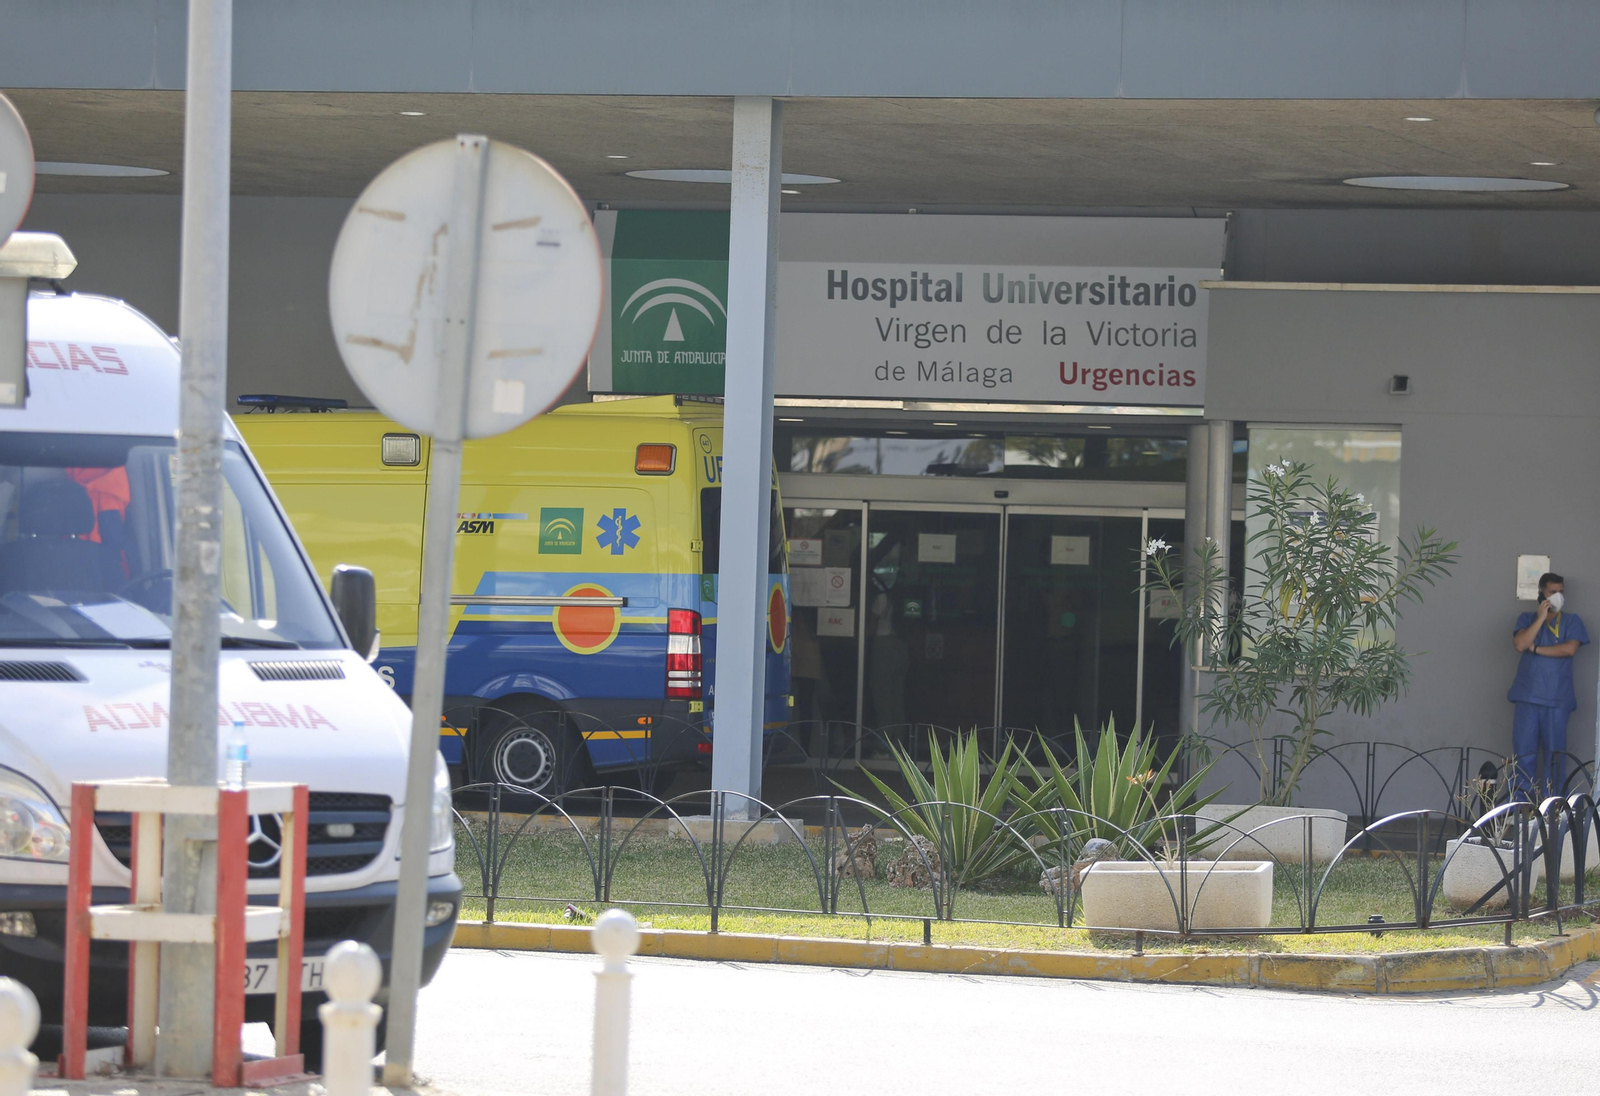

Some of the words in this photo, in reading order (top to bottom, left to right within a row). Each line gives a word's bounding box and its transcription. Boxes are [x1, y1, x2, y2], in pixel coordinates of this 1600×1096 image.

[826, 269, 963, 308] Hospital
[982, 272, 1197, 308] Universitario
[875, 316, 966, 348] Virgen
[986, 319, 1022, 344] de
[1043, 320, 1066, 345] la
[1086, 320, 1197, 347] Victoria
[27, 341, 129, 375] CIAS
[620, 350, 653, 363] JUNTA
[657, 350, 670, 364] DE
[874, 360, 905, 382] de
[917, 360, 1013, 388] Málaga
[1059, 361, 1196, 391] Urgencias
[456, 520, 494, 534] ASM
[828, 617, 843, 625] RAC
